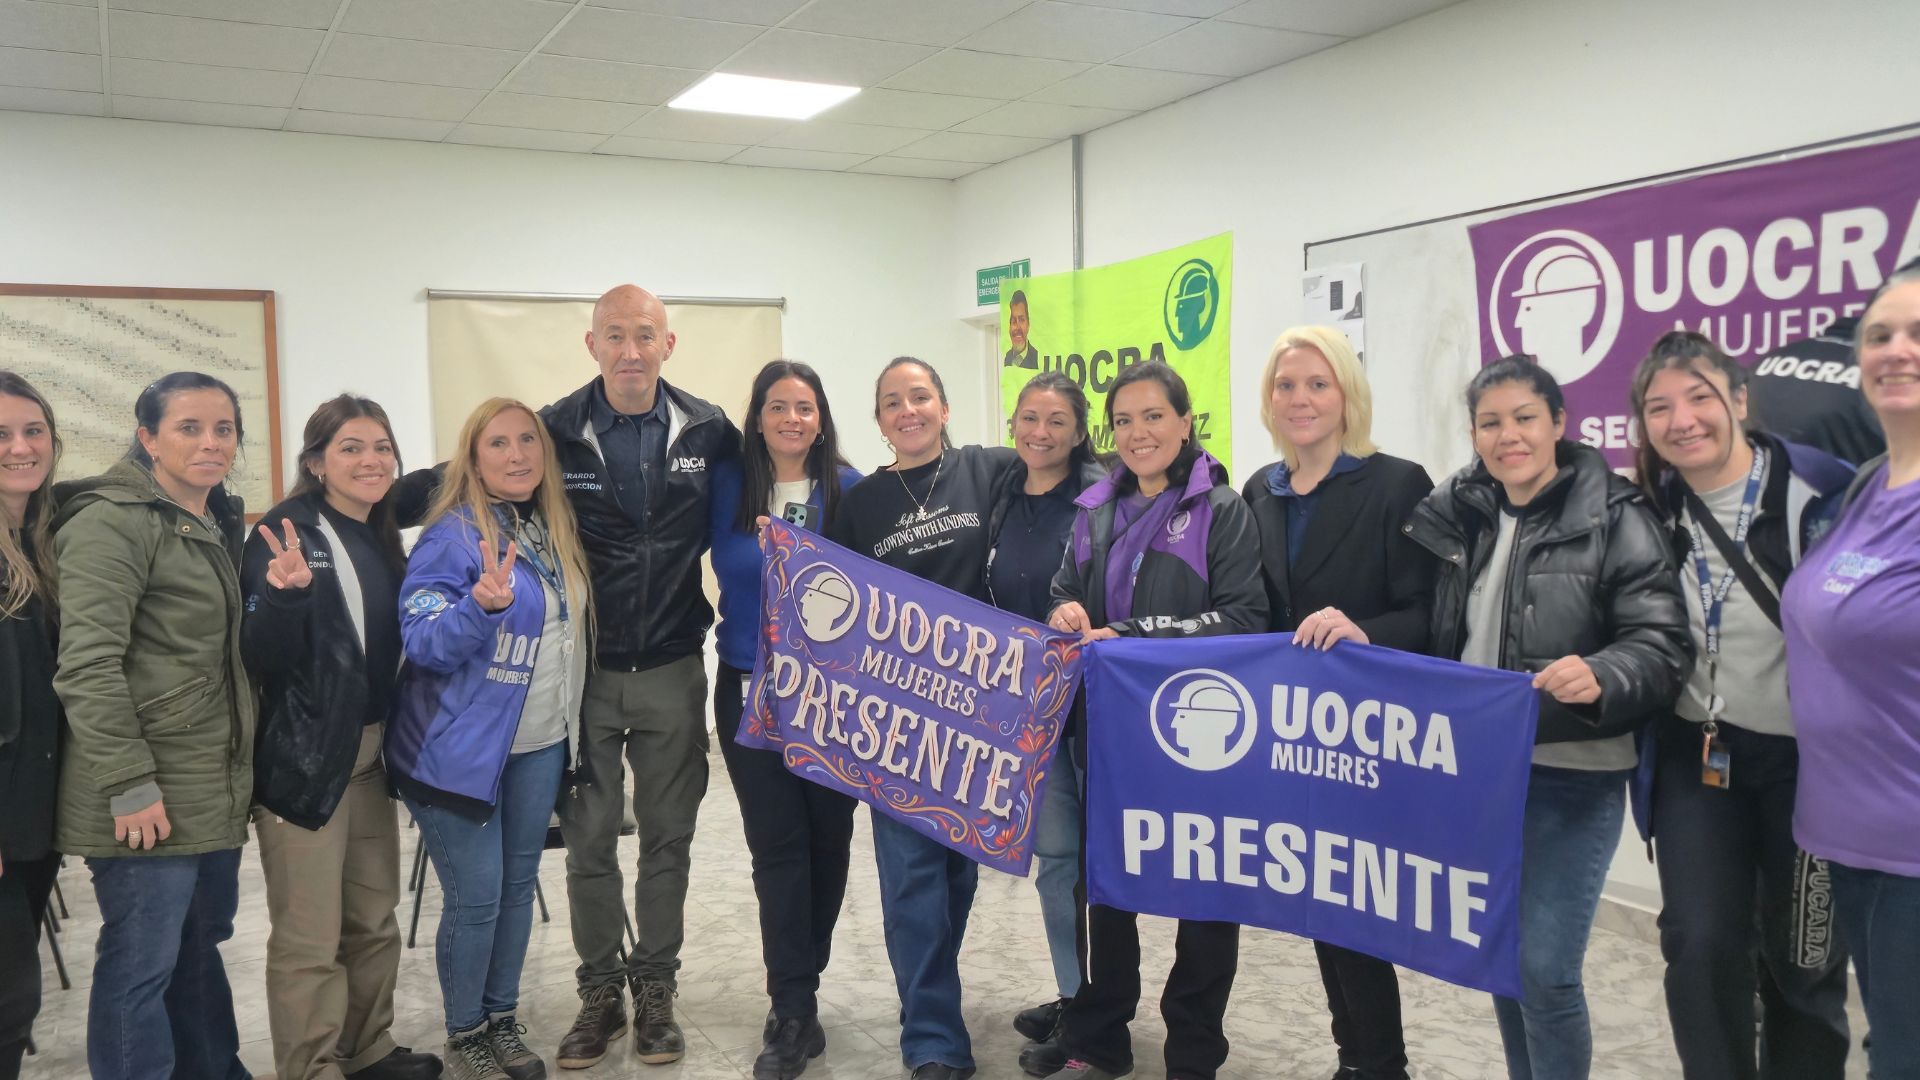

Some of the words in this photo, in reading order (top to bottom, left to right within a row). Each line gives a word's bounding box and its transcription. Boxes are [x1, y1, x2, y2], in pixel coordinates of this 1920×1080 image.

[1674, 303, 1866, 357] UJER
[1755, 356, 1862, 390] UOCRA
[563, 472, 596, 480] ERARDO
[873, 528, 915, 558] GLOWING
[912, 521, 940, 540] WITH
[936, 512, 981, 533] KINDNESS
[867, 583, 1025, 697] UOCRA
[859, 644, 977, 718] MUJERES
[773, 652, 1022, 821] PRESENTE
[1271, 684, 1458, 776] UOCRA
[1270, 741, 1380, 789] MUJERES
[1122, 808, 1489, 949] PRESENTE
